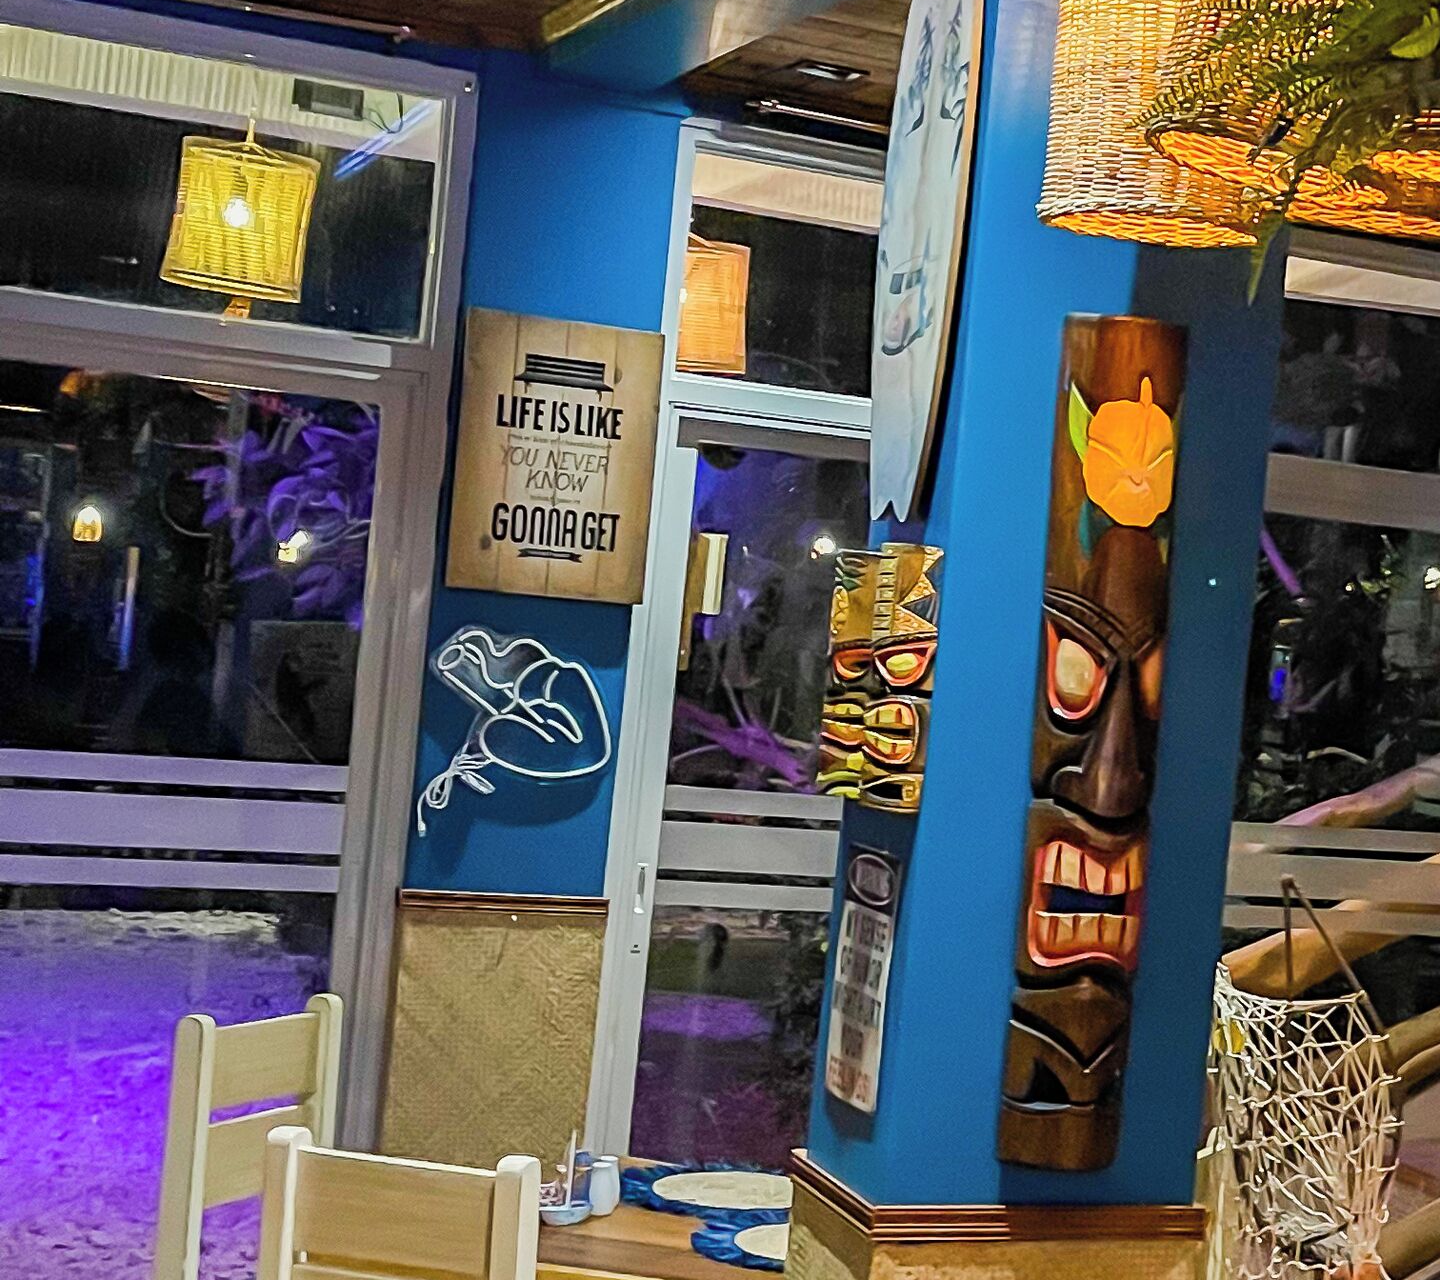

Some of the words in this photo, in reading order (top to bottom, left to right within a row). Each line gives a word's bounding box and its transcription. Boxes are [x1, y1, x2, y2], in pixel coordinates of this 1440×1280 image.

[496, 393, 546, 431] LIFE
[550, 400, 571, 434] IS
[574, 403, 624, 440] LIKE
[500, 443, 540, 468] YOU
[545, 449, 609, 476] NEVER
[525, 468, 589, 493] KNOW
[491, 502, 578, 548] GONNA
[581, 511, 621, 553] GET
